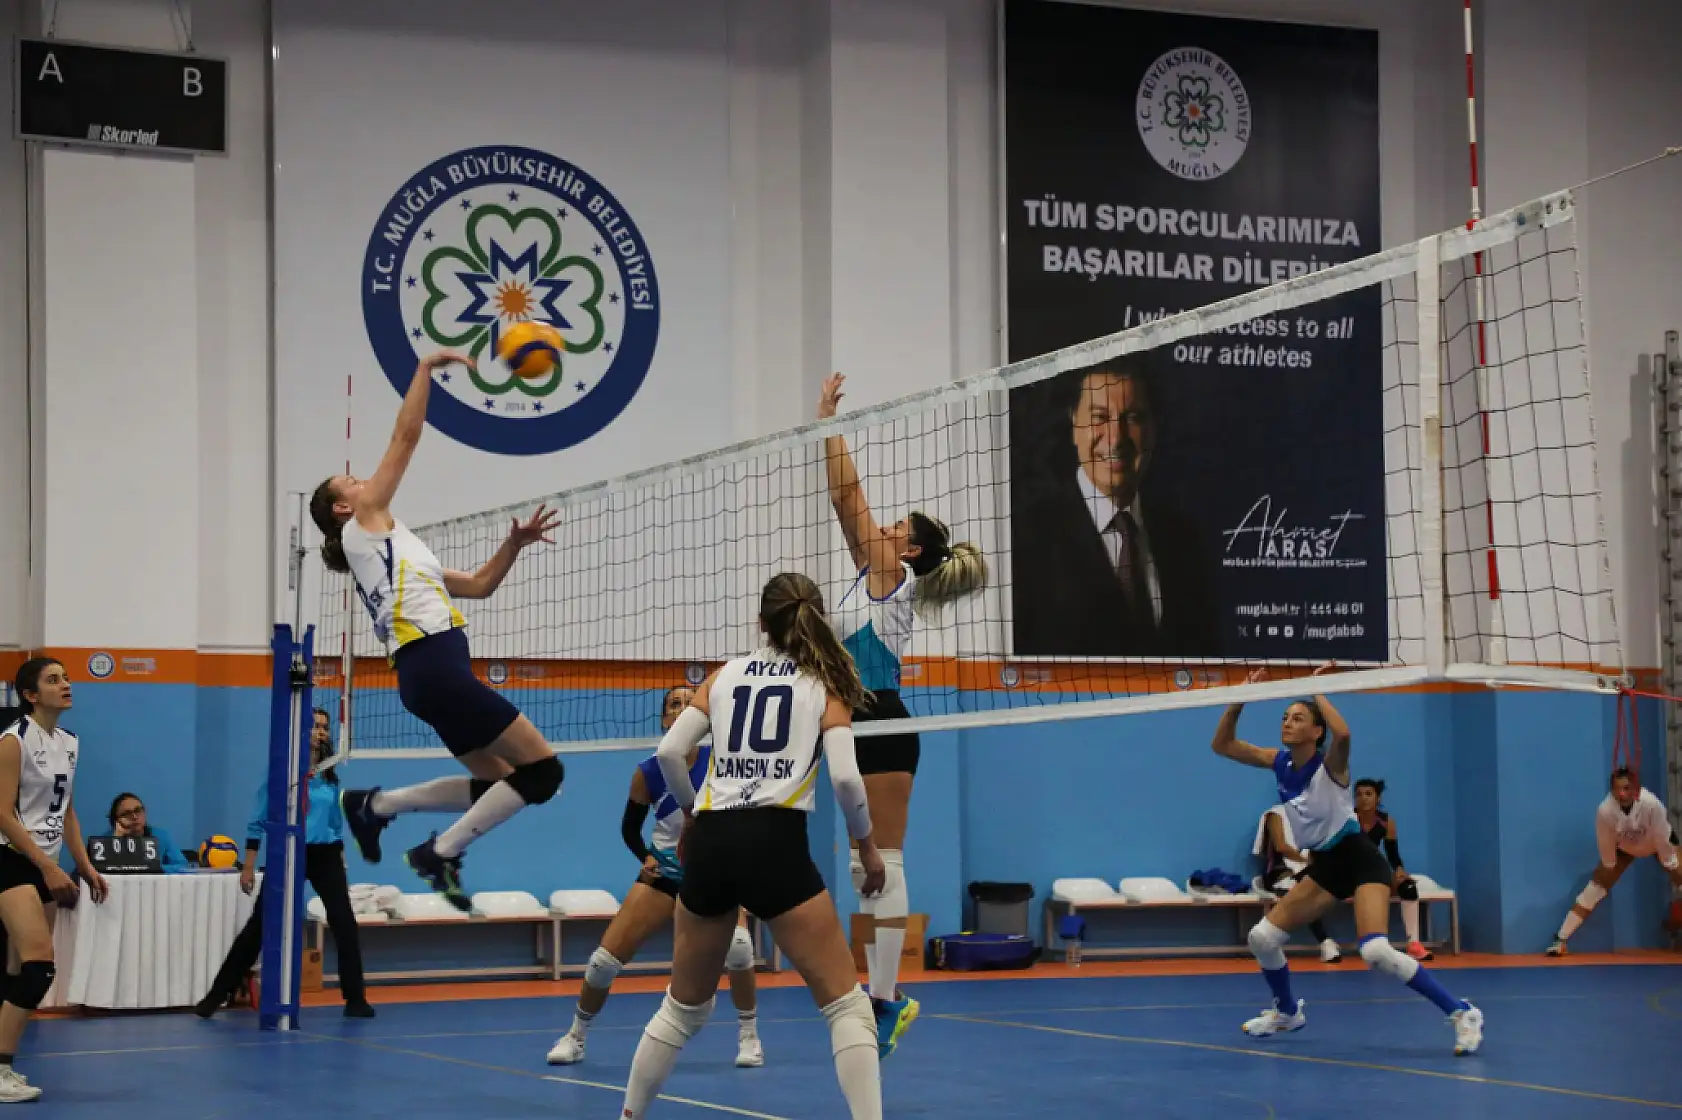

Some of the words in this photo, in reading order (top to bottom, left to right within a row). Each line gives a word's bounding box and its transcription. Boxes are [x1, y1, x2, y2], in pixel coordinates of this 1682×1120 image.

[38, 51, 64, 83] A
[183, 66, 203, 97] B
[446, 151, 587, 201] BÜYÜKŞEHİR
[383, 175, 448, 248] MUĞLA
[1023, 193, 1088, 229] TÜM
[1095, 204, 1361, 247] SPORCULARIMIZA
[372, 252, 396, 295] T.C.
[586, 194, 655, 311] BELEDİYESİ
[1043, 245, 1215, 282] BAŞARILAR
[1222, 250, 1345, 285] DİLERİ
[1123, 304, 1133, 328] I
[1296, 318, 1319, 339] to
[1326, 316, 1355, 339] all
[1173, 342, 1212, 365] our
[1217, 343, 1312, 369] athletes
[1222, 493, 1366, 557] Ahmet
[1265, 539, 1327, 558] ARAS
[728, 685, 793, 753] 10
[773, 758, 795, 779] SK
[48, 773, 68, 813] 5
[93, 841, 106, 861] 2
[144, 839, 157, 860] 5
